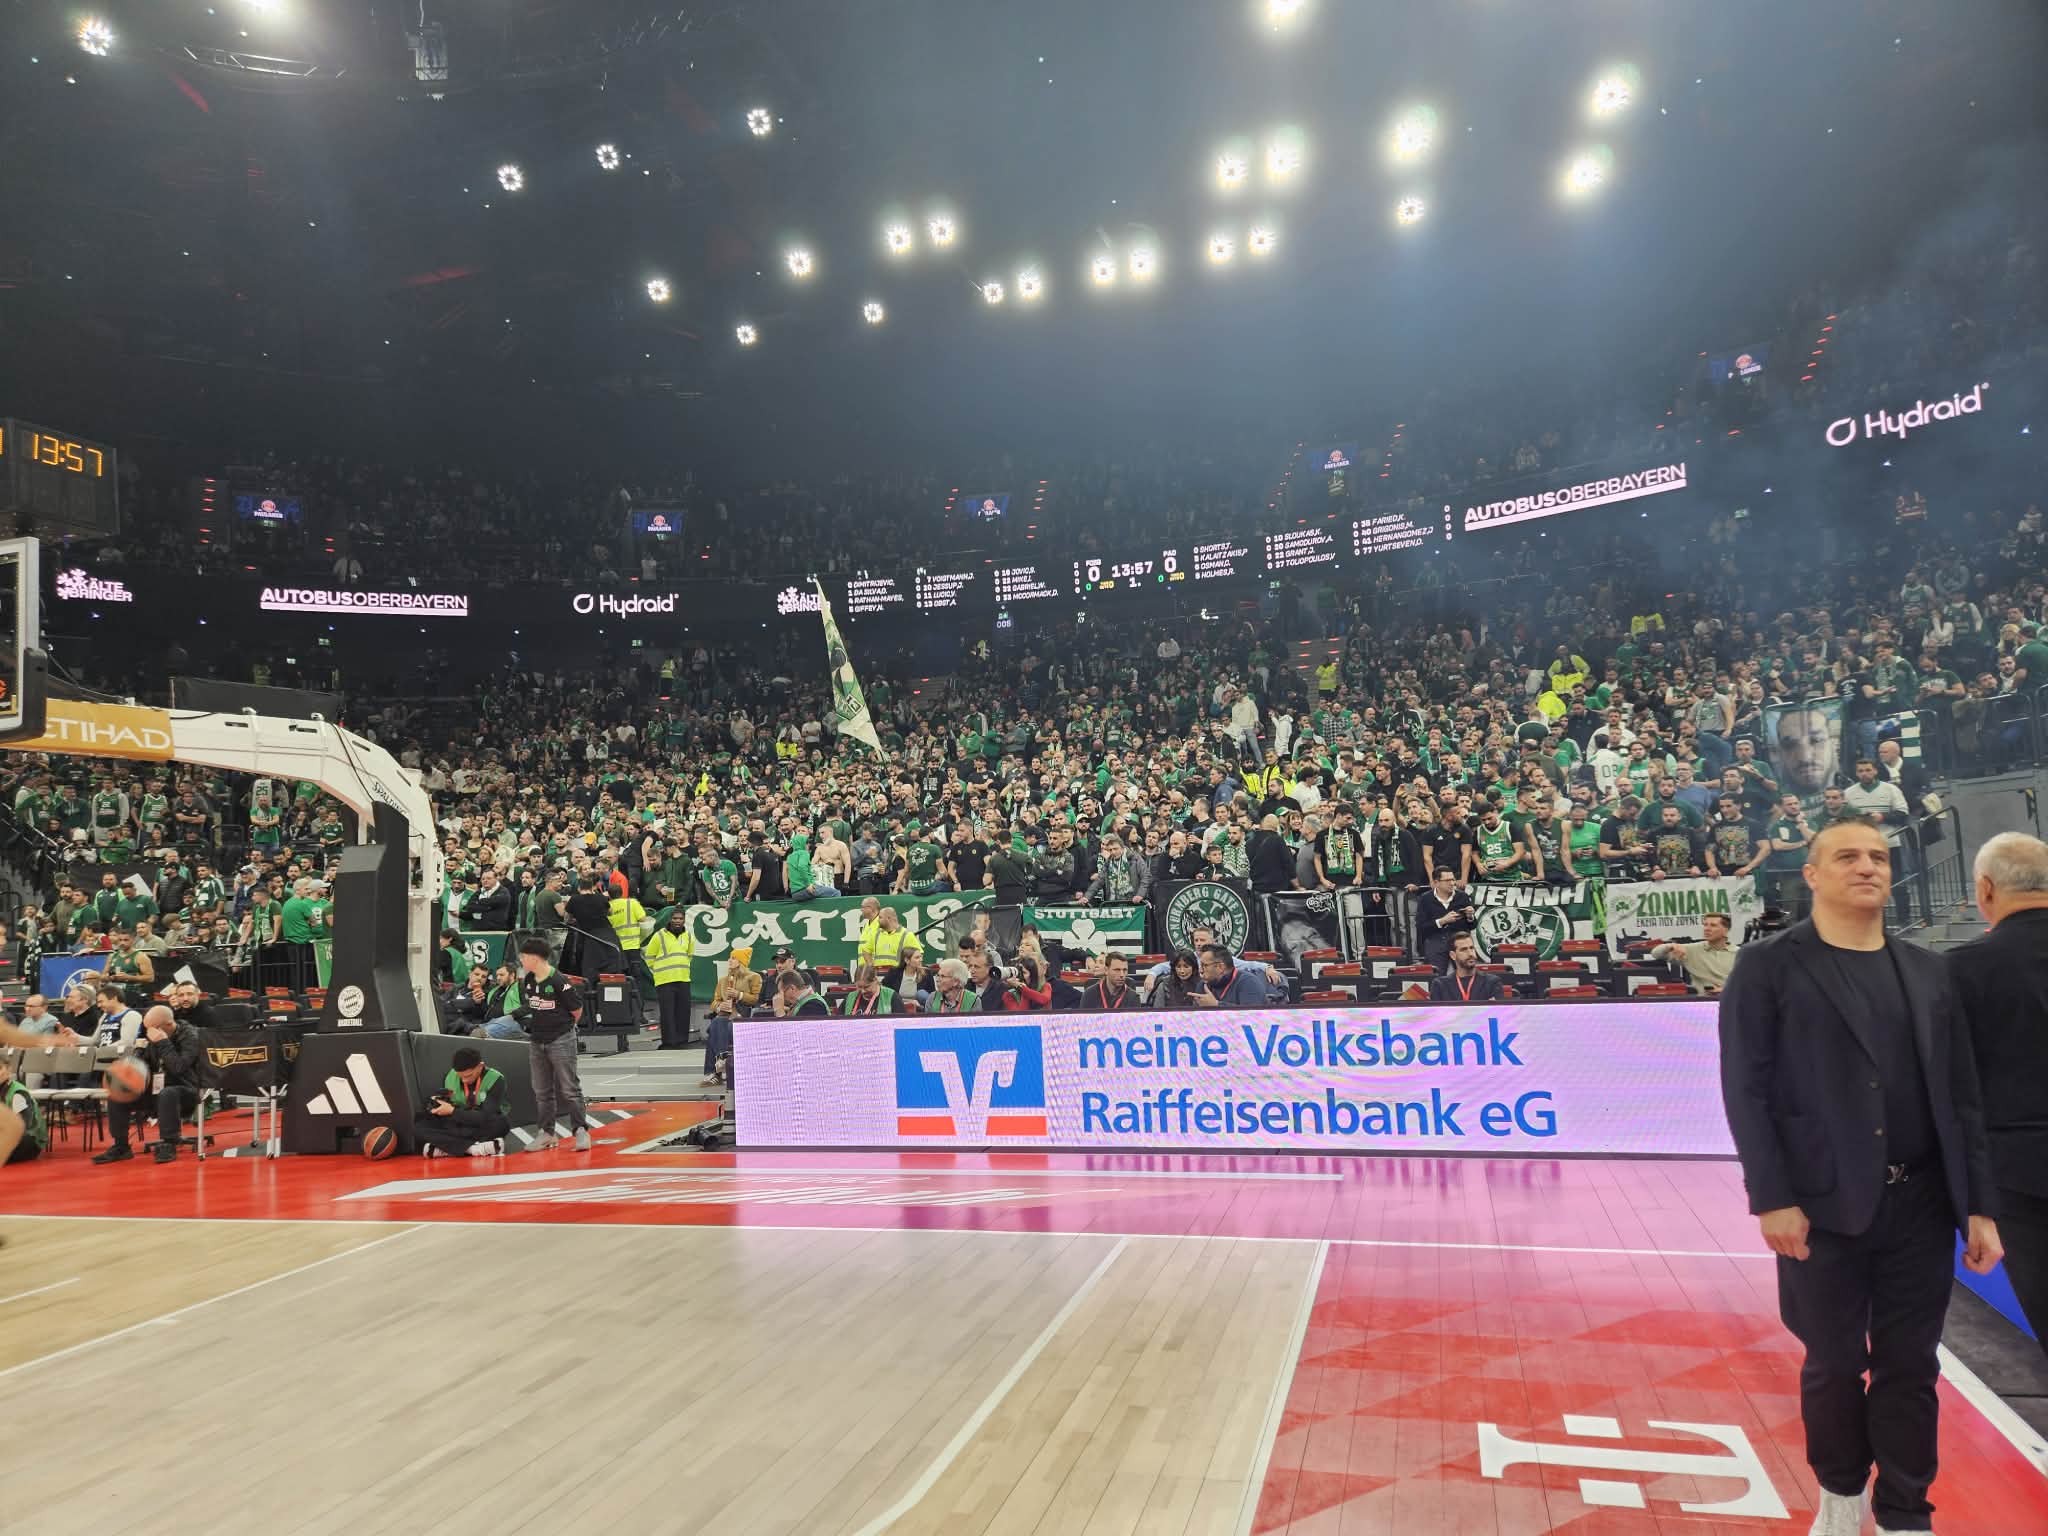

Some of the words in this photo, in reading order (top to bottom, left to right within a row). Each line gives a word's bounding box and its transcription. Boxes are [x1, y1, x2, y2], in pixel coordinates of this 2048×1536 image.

[1864, 384, 1982, 439] Hydraid
[32, 433, 103, 477] 13:57
[1464, 462, 1685, 523] AUTOBUSOBERBAYERN
[1088, 566, 1100, 582] 0
[1111, 561, 1153, 577] 13:57
[1164, 557, 1177, 573] 0
[260, 588, 467, 609] AUTOBUSOBERBAYERN
[599, 594, 674, 619] Hydraid
[791, 593, 820, 604] KÄLT
[46, 717, 171, 749] ETIHAD
[1487, 843, 1502, 855] 25
[1034, 907, 1136, 919] STUTTGART
[1490, 911, 1512, 934] 13
[1079, 1024, 1228, 1068] meine
[1241, 1017, 1524, 1067] Volksbank
[1083, 1087, 1466, 1137] Raiffeisenbank
[1480, 1091, 1557, 1137] eG
